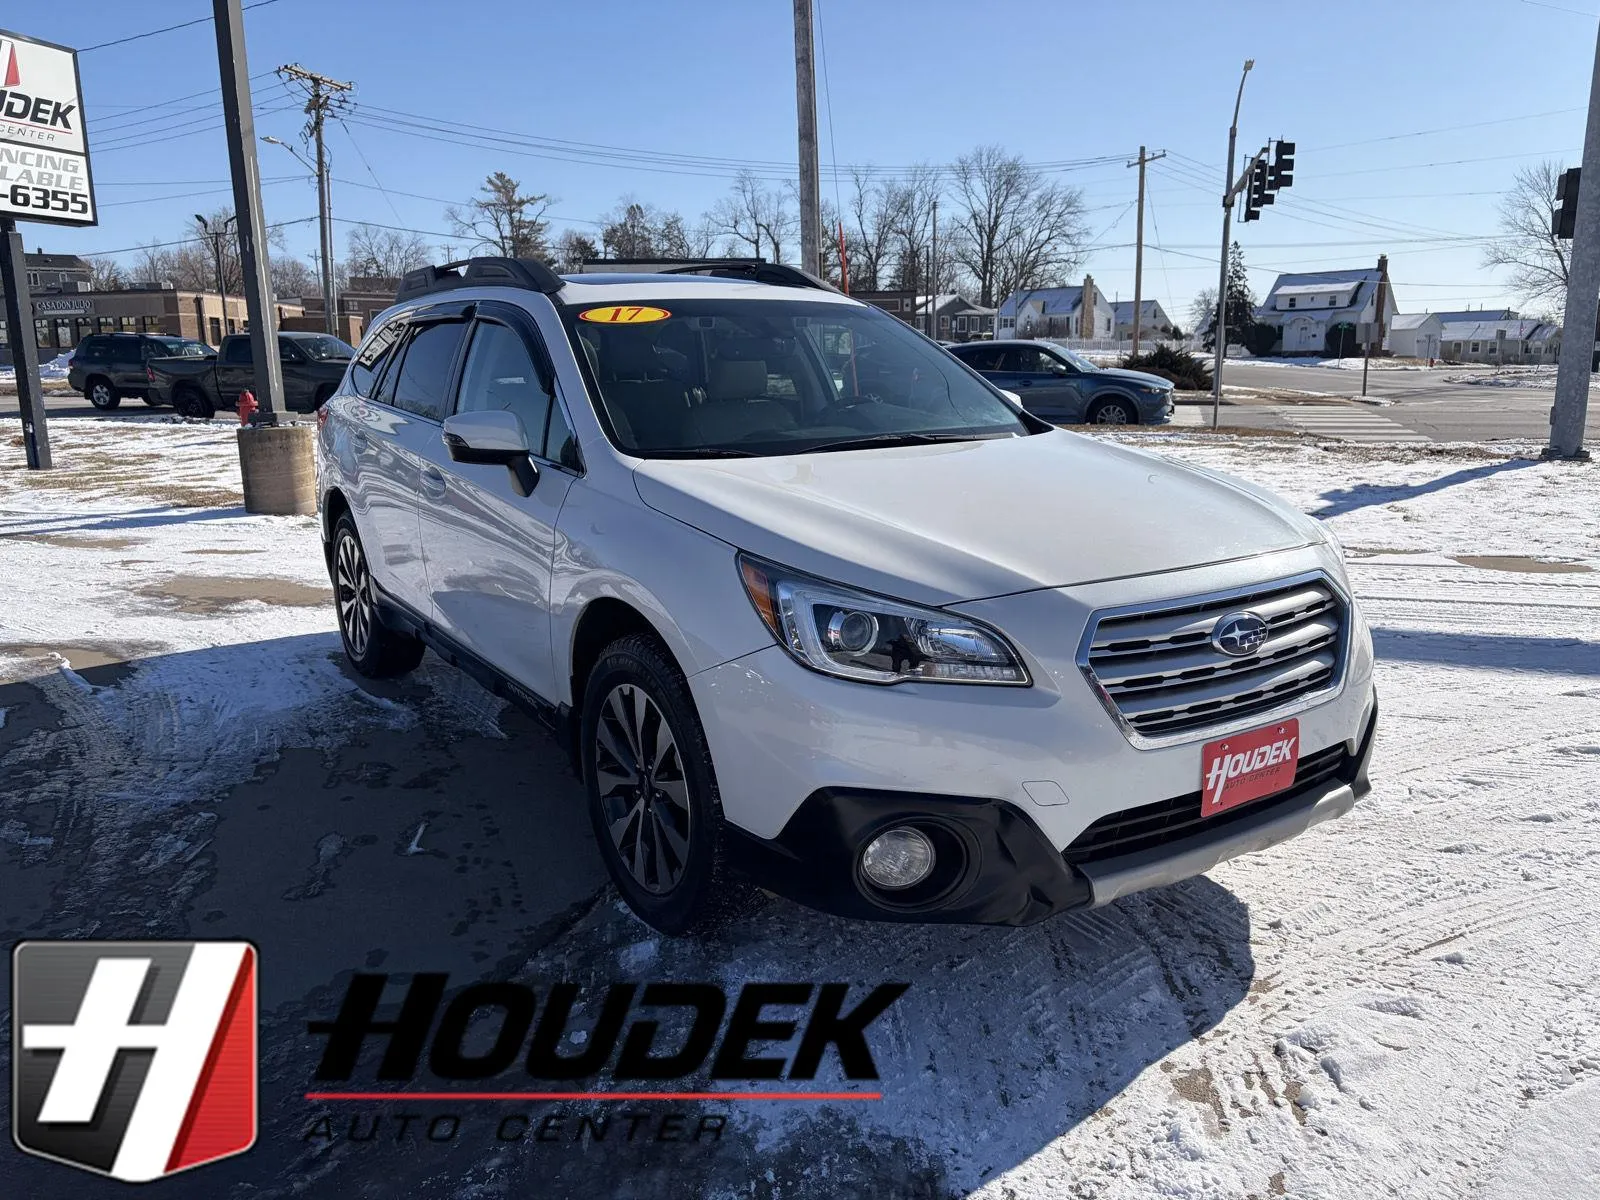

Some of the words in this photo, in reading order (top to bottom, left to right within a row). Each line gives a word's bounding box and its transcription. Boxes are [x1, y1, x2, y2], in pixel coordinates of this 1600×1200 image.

[0, 148, 79, 173] NCING
[0, 165, 83, 191] LABLE
[36, 301, 56, 310] CASA
[56, 300, 71, 309] DON
[72, 299, 91, 309] JULIO
[610, 307, 645, 321] 17
[1206, 736, 1297, 804] HOUDEK
[1224, 776, 1246, 790] AUTO
[1248, 767, 1281, 783] CENTER
